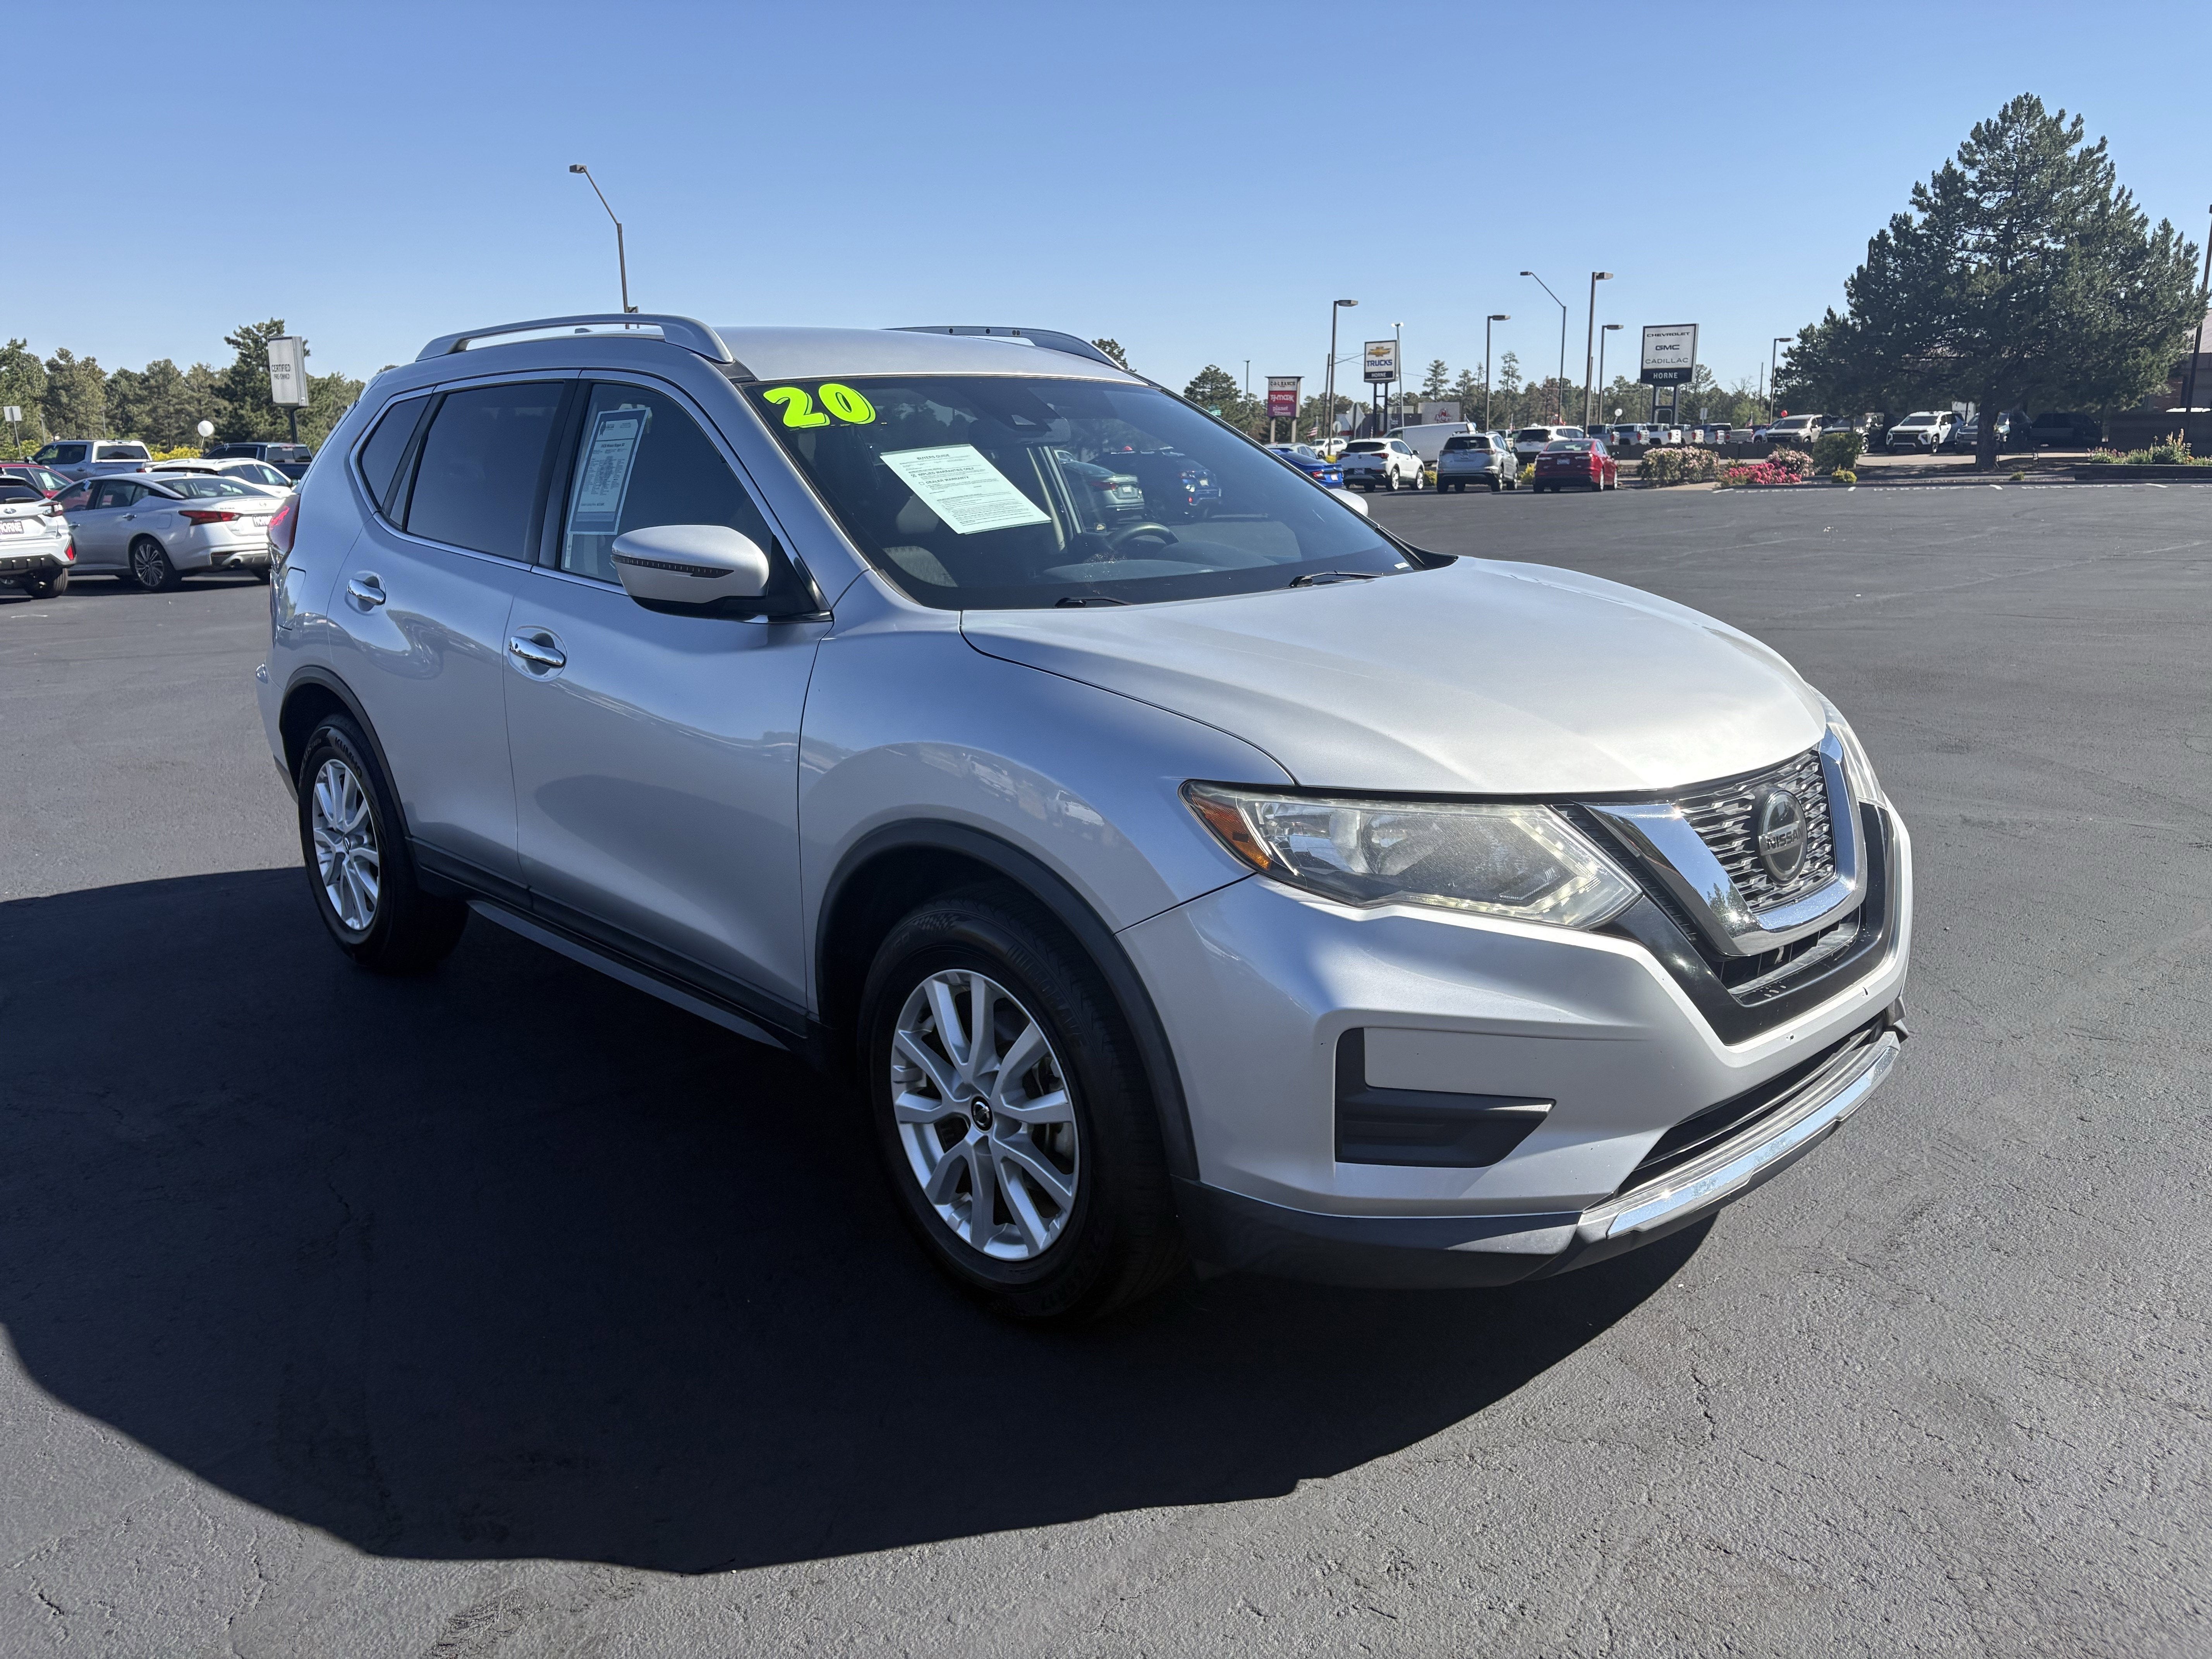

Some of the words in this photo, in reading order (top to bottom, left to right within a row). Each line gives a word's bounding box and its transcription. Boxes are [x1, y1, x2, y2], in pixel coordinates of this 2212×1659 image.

[271, 364, 291, 373] CERTIFIED
[763, 383, 876, 428] 20
[1767, 826, 1803, 850] NISSAN
